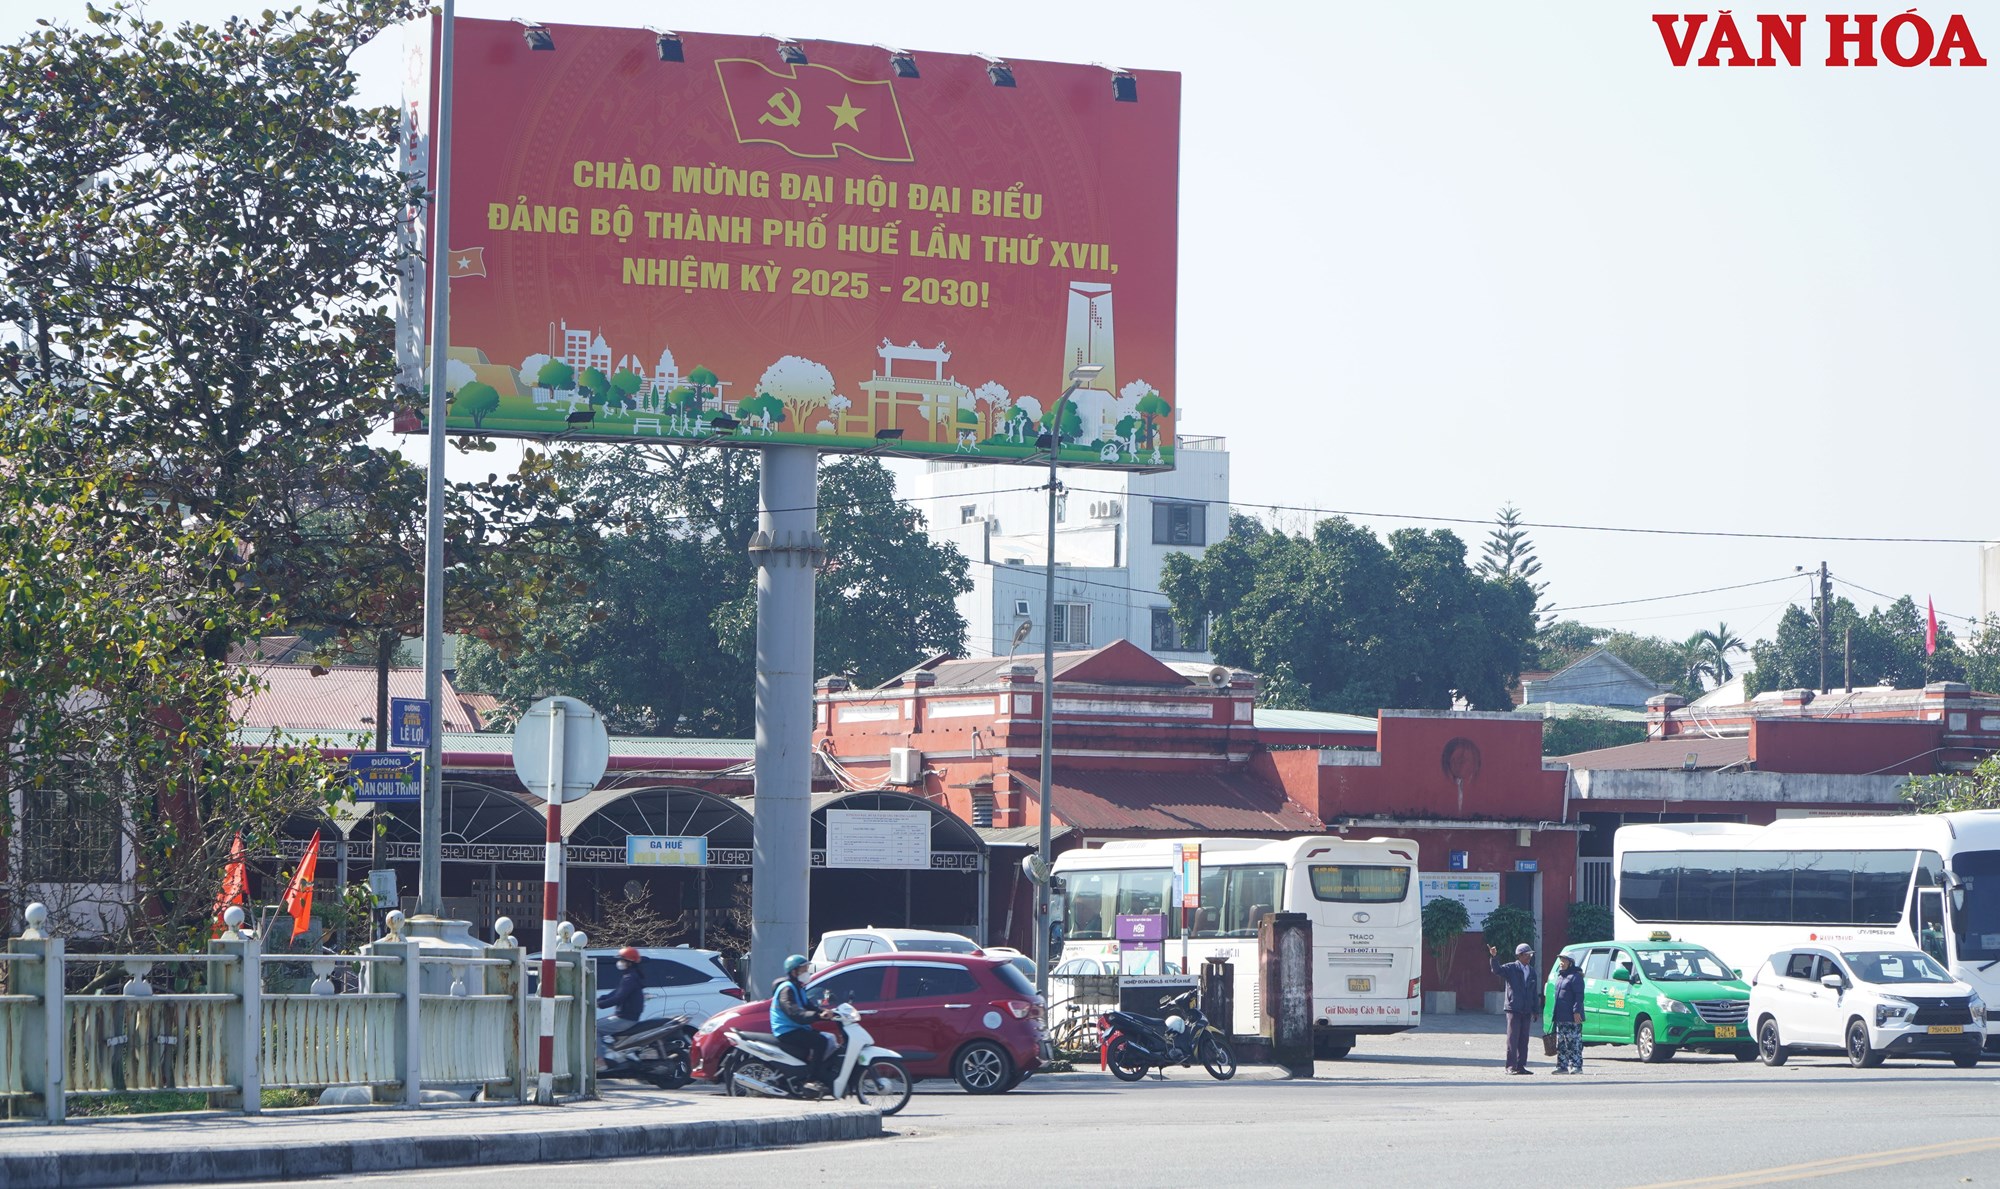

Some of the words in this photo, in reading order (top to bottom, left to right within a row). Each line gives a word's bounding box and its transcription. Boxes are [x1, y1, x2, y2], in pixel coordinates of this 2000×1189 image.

[573, 157, 661, 191] CHÀO
[673, 162, 770, 198] MỪNG
[780, 173, 833, 208] ĐẠI
[845, 175, 897, 213] HỘI
[908, 183, 960, 218] ĐẠI
[972, 181, 1042, 220] BIỂU
[487, 195, 579, 234] ĐẢNG
[591, 204, 634, 243] BỘ
[644, 208, 752, 244] THÀNH
[763, 213, 827, 249] PHỐ
[838, 220, 902, 254] HUẾ
[910, 223, 970, 261] LẦN
[981, 233, 1044, 265] THỨ
[1049, 240, 1118, 275] XVII,
[622, 255, 729, 294] NHIỆM
[741, 260, 782, 293] KỲ
[791, 267, 869, 299] 2025
[901, 276, 989, 308] 2030!
[404, 704, 420, 712] ĐƯỜNG
[401, 724, 410, 741] LÊ
[412, 726, 424, 745] LỢI
[371, 757, 401, 766] ĐƯỜNG
[353, 782, 376, 795] PHAN
[377, 782, 394, 795] CHU
[650, 841, 662, 849] GA
[665, 839, 683, 849] HUẾ
[1337, 1004, 1358, 1016] Khoảng
[1360, 1005, 1374, 1015] Cách
[1376, 1005, 1385, 1014] An
[1386, 1005, 1400, 1015] Toàn
